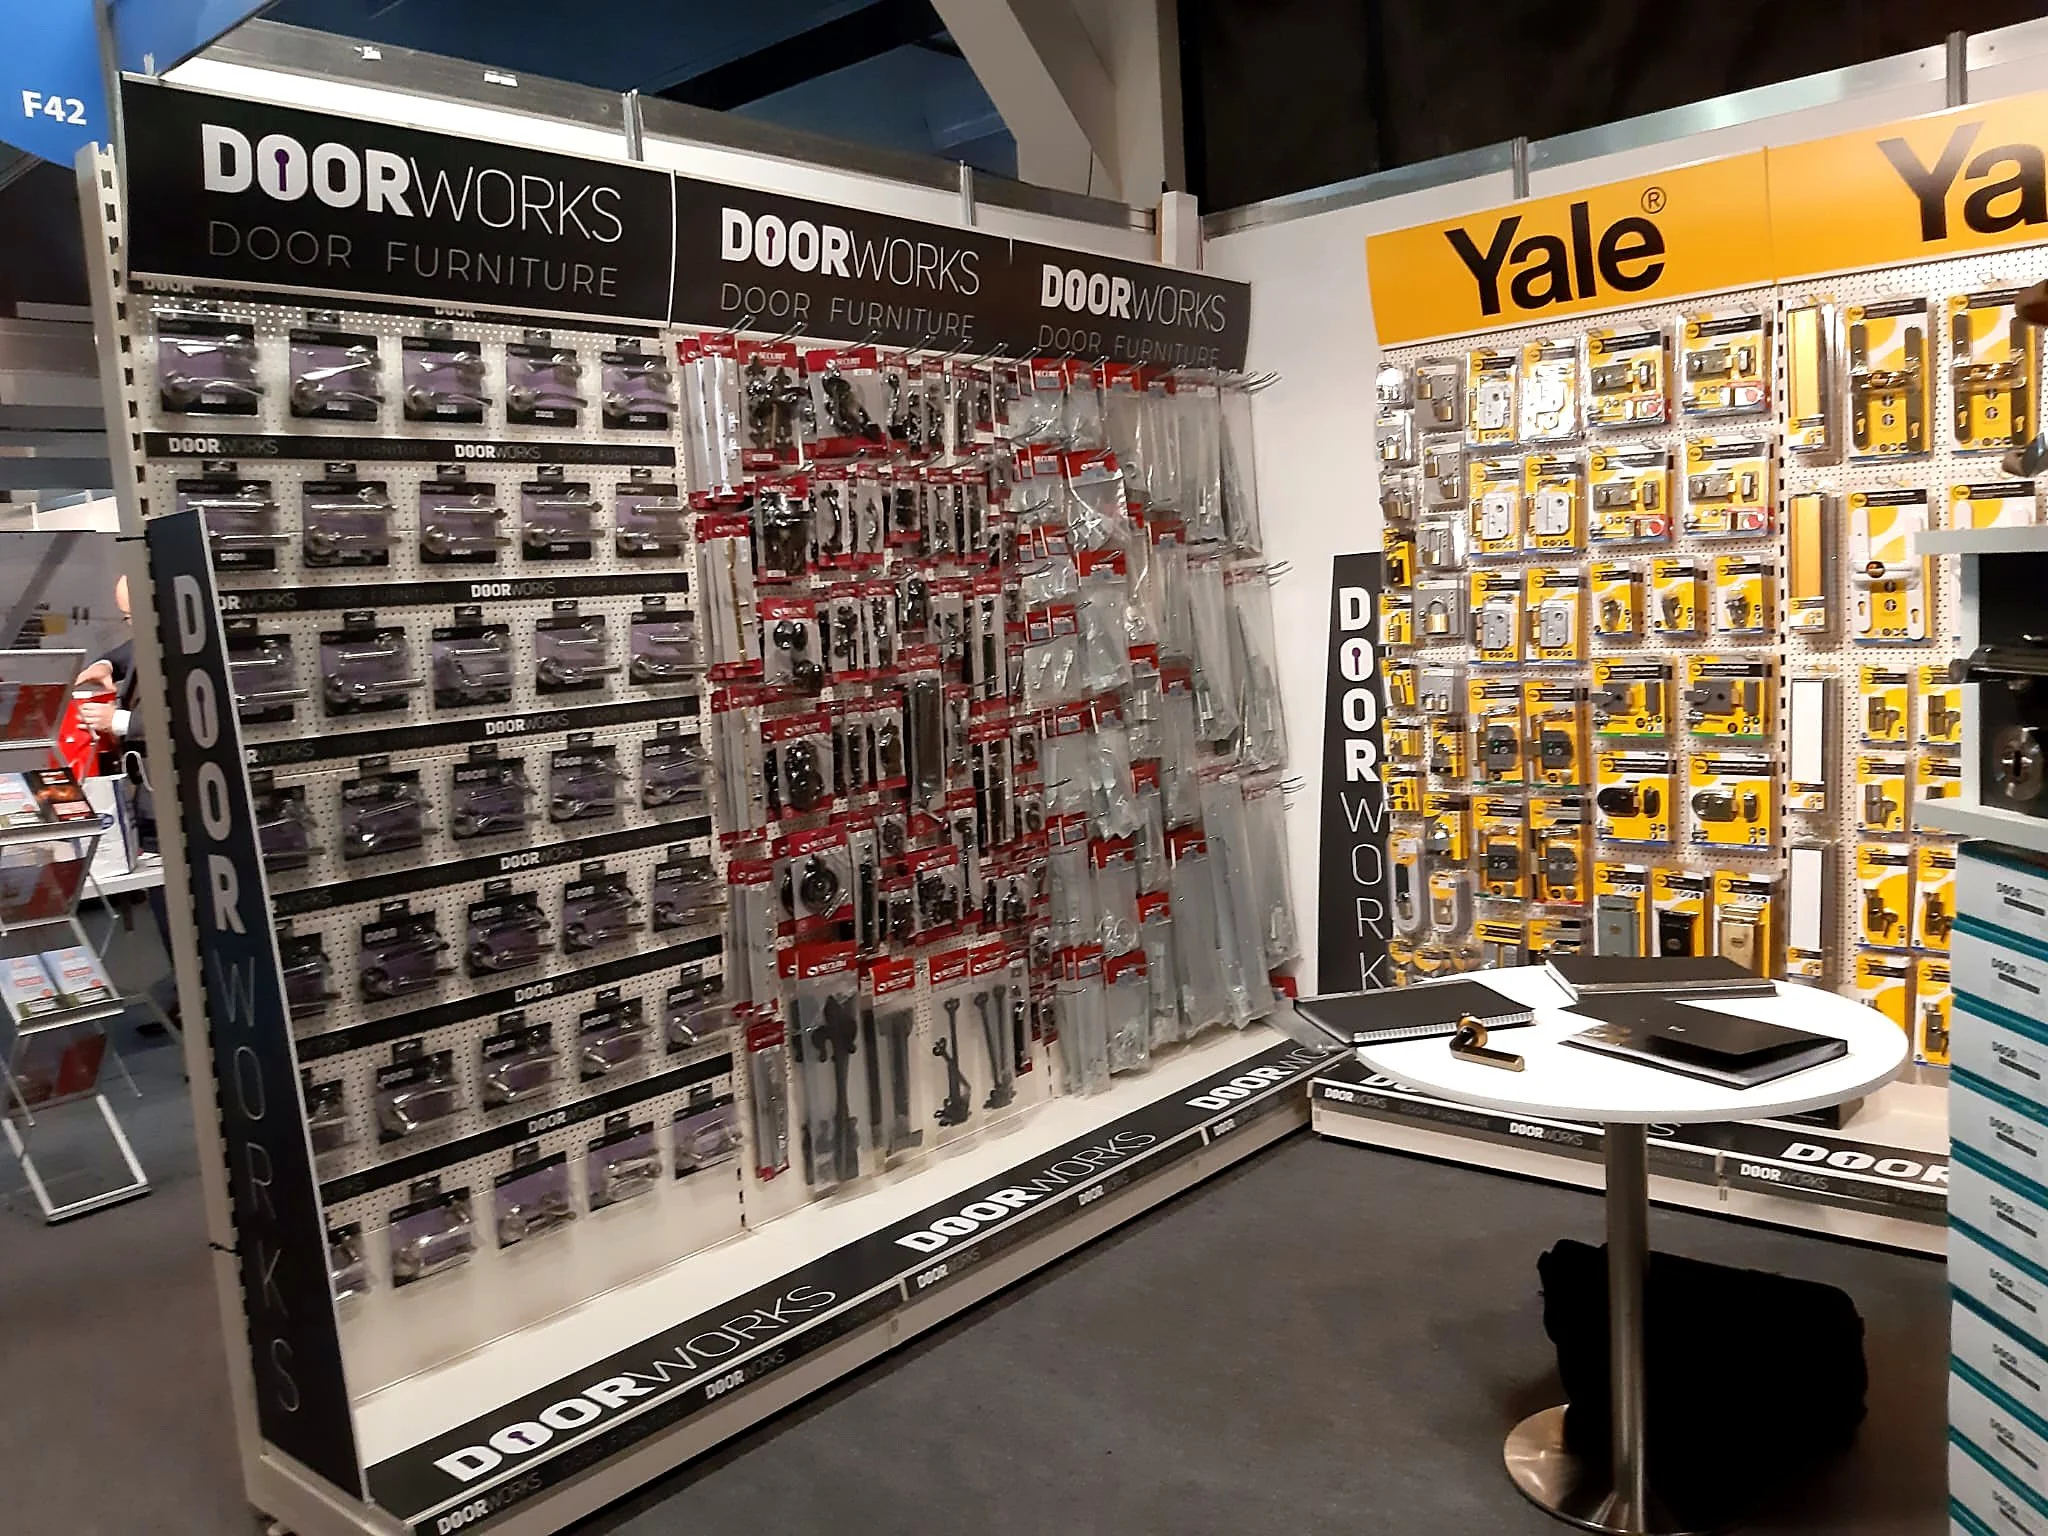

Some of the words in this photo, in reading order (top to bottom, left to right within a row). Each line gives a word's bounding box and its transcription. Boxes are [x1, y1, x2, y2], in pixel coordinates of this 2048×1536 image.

[22, 90, 88, 125] F42
[201, 123, 624, 242] DOORWORKS
[1877, 121, 2048, 242] Ya
[209, 220, 352, 268] DOOR
[386, 241, 618, 297] FURNITURE
[721, 207, 981, 296] DOORWORKS
[721, 283, 810, 320] DOOR
[830, 297, 976, 340] FURNITURE
[1041, 264, 1227, 333] DOORWORKS
[1039, 325, 1101, 354] DOOR
[168, 437, 279, 455] DOORWORKS
[454, 444, 541, 461] DOORWORKS
[895, 1130, 1156, 1253] DOORWORKS
[1740, 1163, 1831, 1190] DOORWORKS
[433, 1285, 836, 1483] DOORWORKS
